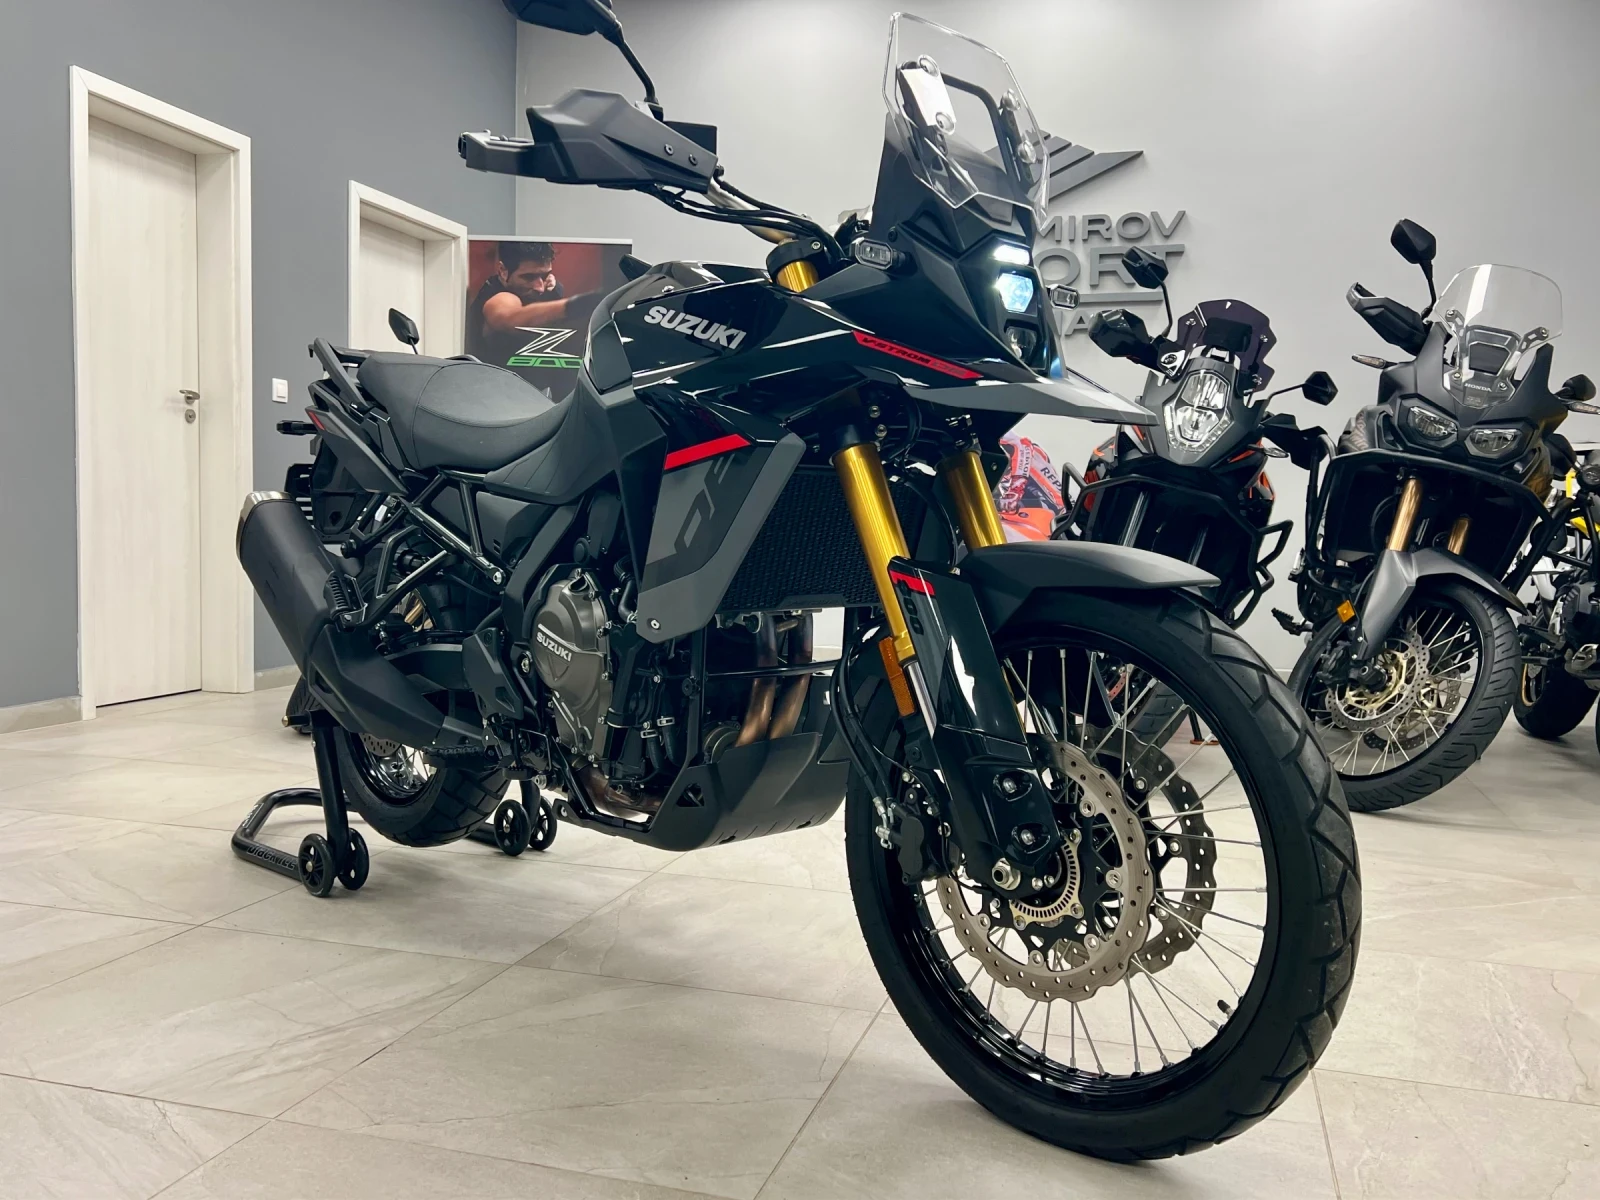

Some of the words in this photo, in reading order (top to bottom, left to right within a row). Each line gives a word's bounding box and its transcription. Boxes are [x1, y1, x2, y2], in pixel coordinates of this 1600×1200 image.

[644, 305, 747, 350] SUZUKI
[514, 326, 580, 358] Z
[861, 337, 932, 364] V-STROM
[506, 356, 583, 369] 800
[1464, 382, 1492, 393] HONDA
[536, 632, 573, 662] SUZUKI
